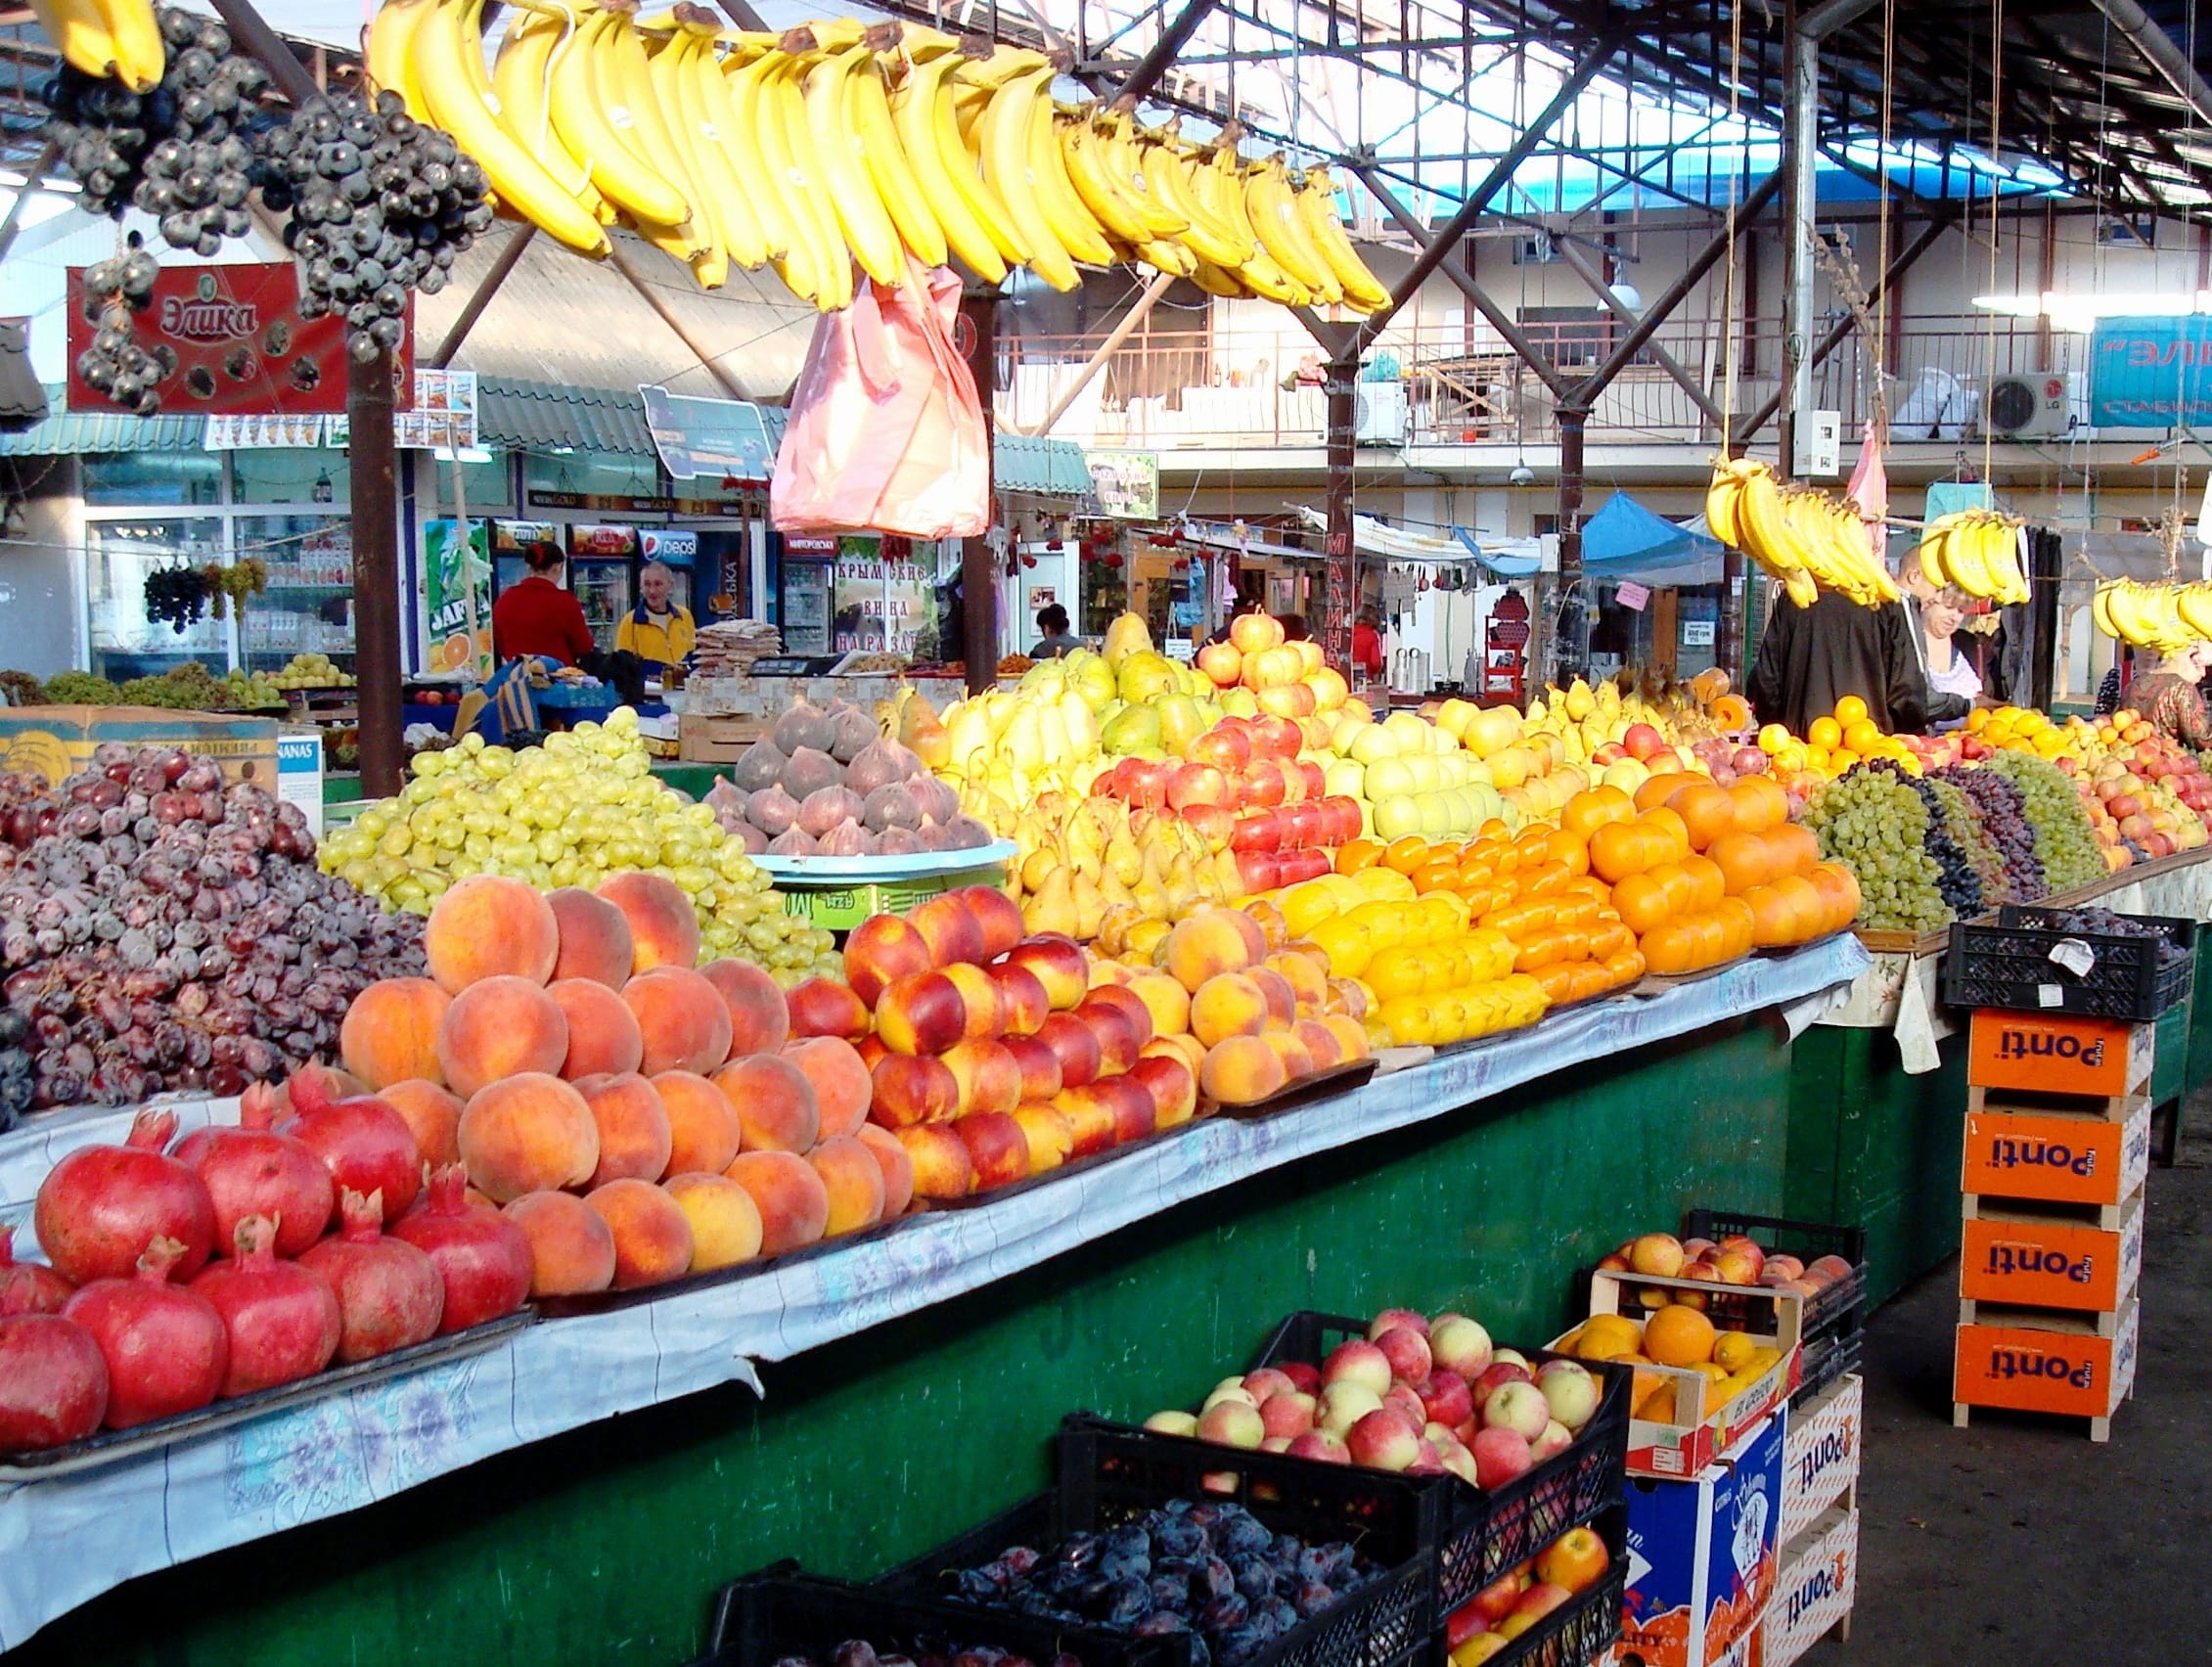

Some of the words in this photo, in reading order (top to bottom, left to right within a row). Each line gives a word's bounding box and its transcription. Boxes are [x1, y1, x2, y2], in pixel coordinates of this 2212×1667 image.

[160, 296, 259, 338] Элика
[2044, 401, 2060, 410] LG
[662, 540, 697, 557] pepsi
[431, 593, 490, 631] JAFA
[1326, 533, 1346, 670] МАЛИНА
[837, 634, 859, 652] НА
[2002, 1031, 2097, 1066] Ponti
[1993, 1139, 2088, 1177] Ponti
[1989, 1246, 2084, 1283] Ponti
[1992, 1351, 2085, 1389] Ponti
[1800, 1431, 1843, 1495] Ponti
[1787, 1569, 1833, 1632] Ponti
